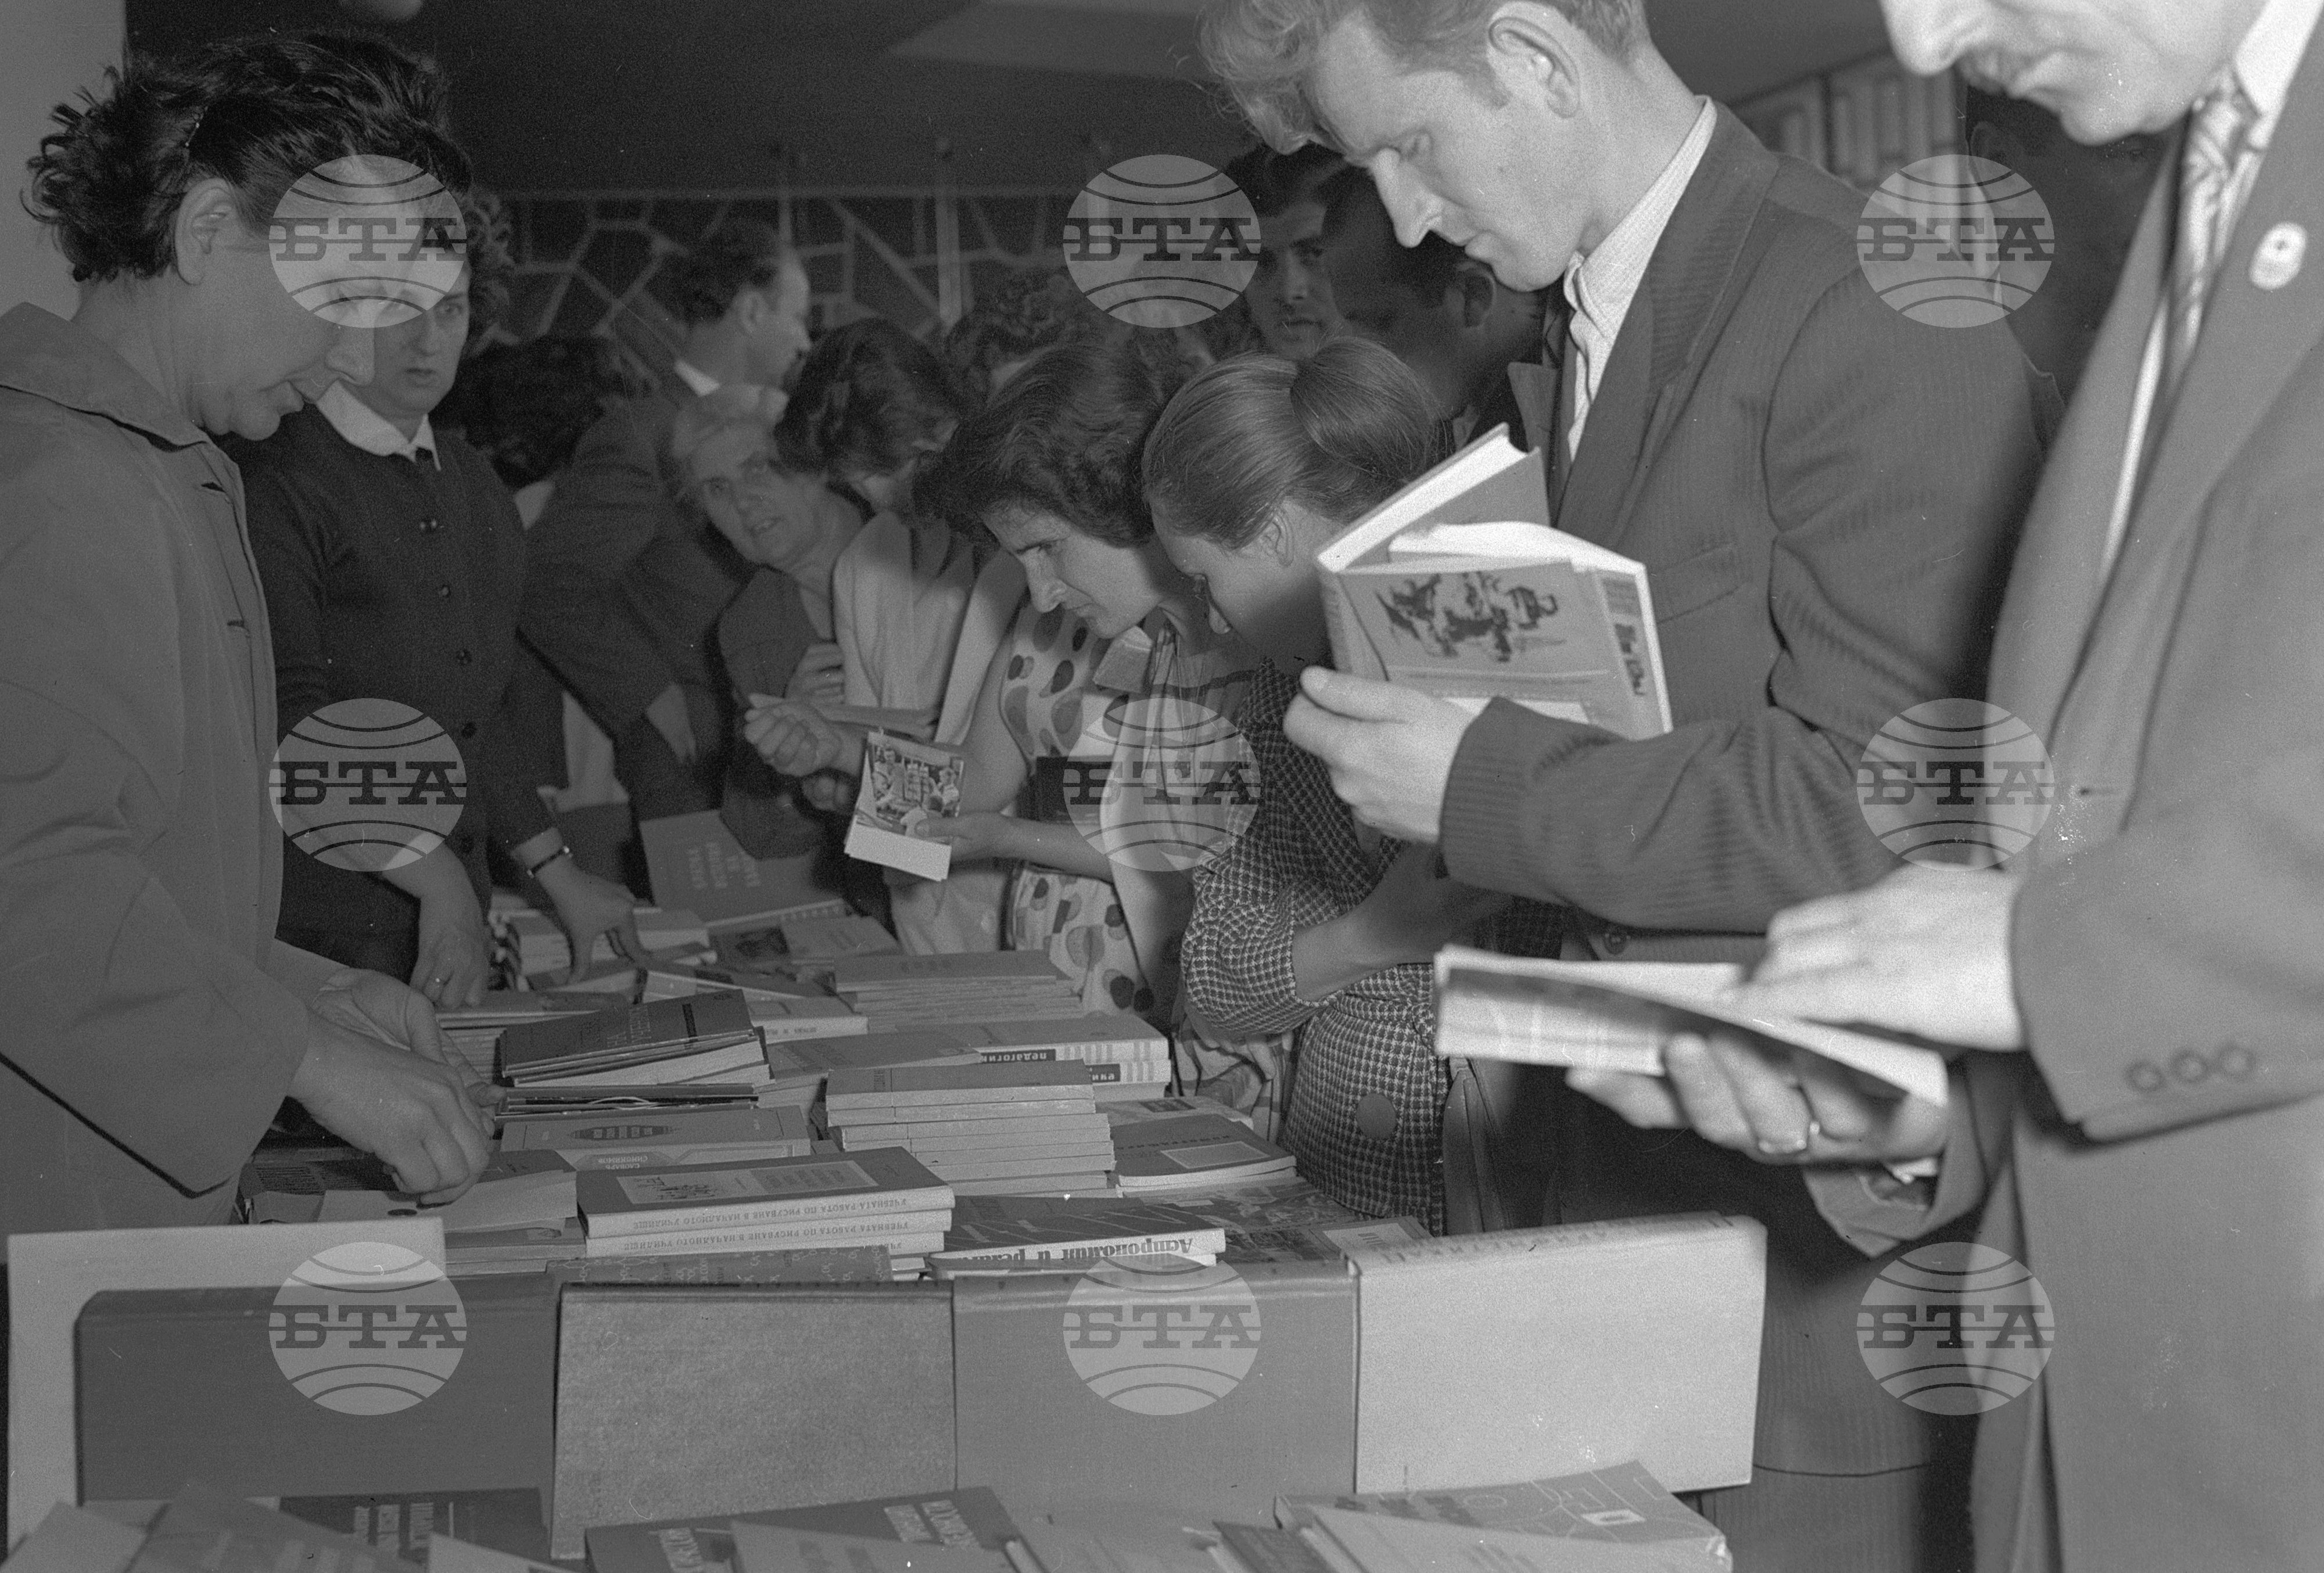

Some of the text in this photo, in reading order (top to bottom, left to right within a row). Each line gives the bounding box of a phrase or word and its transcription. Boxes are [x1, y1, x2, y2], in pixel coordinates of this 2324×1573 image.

[598, 1155, 648, 1164] СИНОНИМОВ
[821, 1202, 856, 1212] РАБОТА
[859, 1198, 907, 1209] УЧЕБНАТА
[683, 1213, 740, 1224] НАЧАЛНОТО
[753, 1208, 800, 1219] РИСУВАНЕ
[633, 1218, 680, 1229] УЧИЛИЩЕ
[860, 1222, 908, 1232] УЧЕБНАТА
[748, 1230, 799, 1240] РИСУВАНЕ
[820, 1226, 856, 1235] РАБОТА
[624, 1240, 673, 1250] УЧИЛИЩЕ
[676, 1235, 736, 1245] НАЧАЛНОТО
[1063, 1238, 1193, 1260] Астрономия
